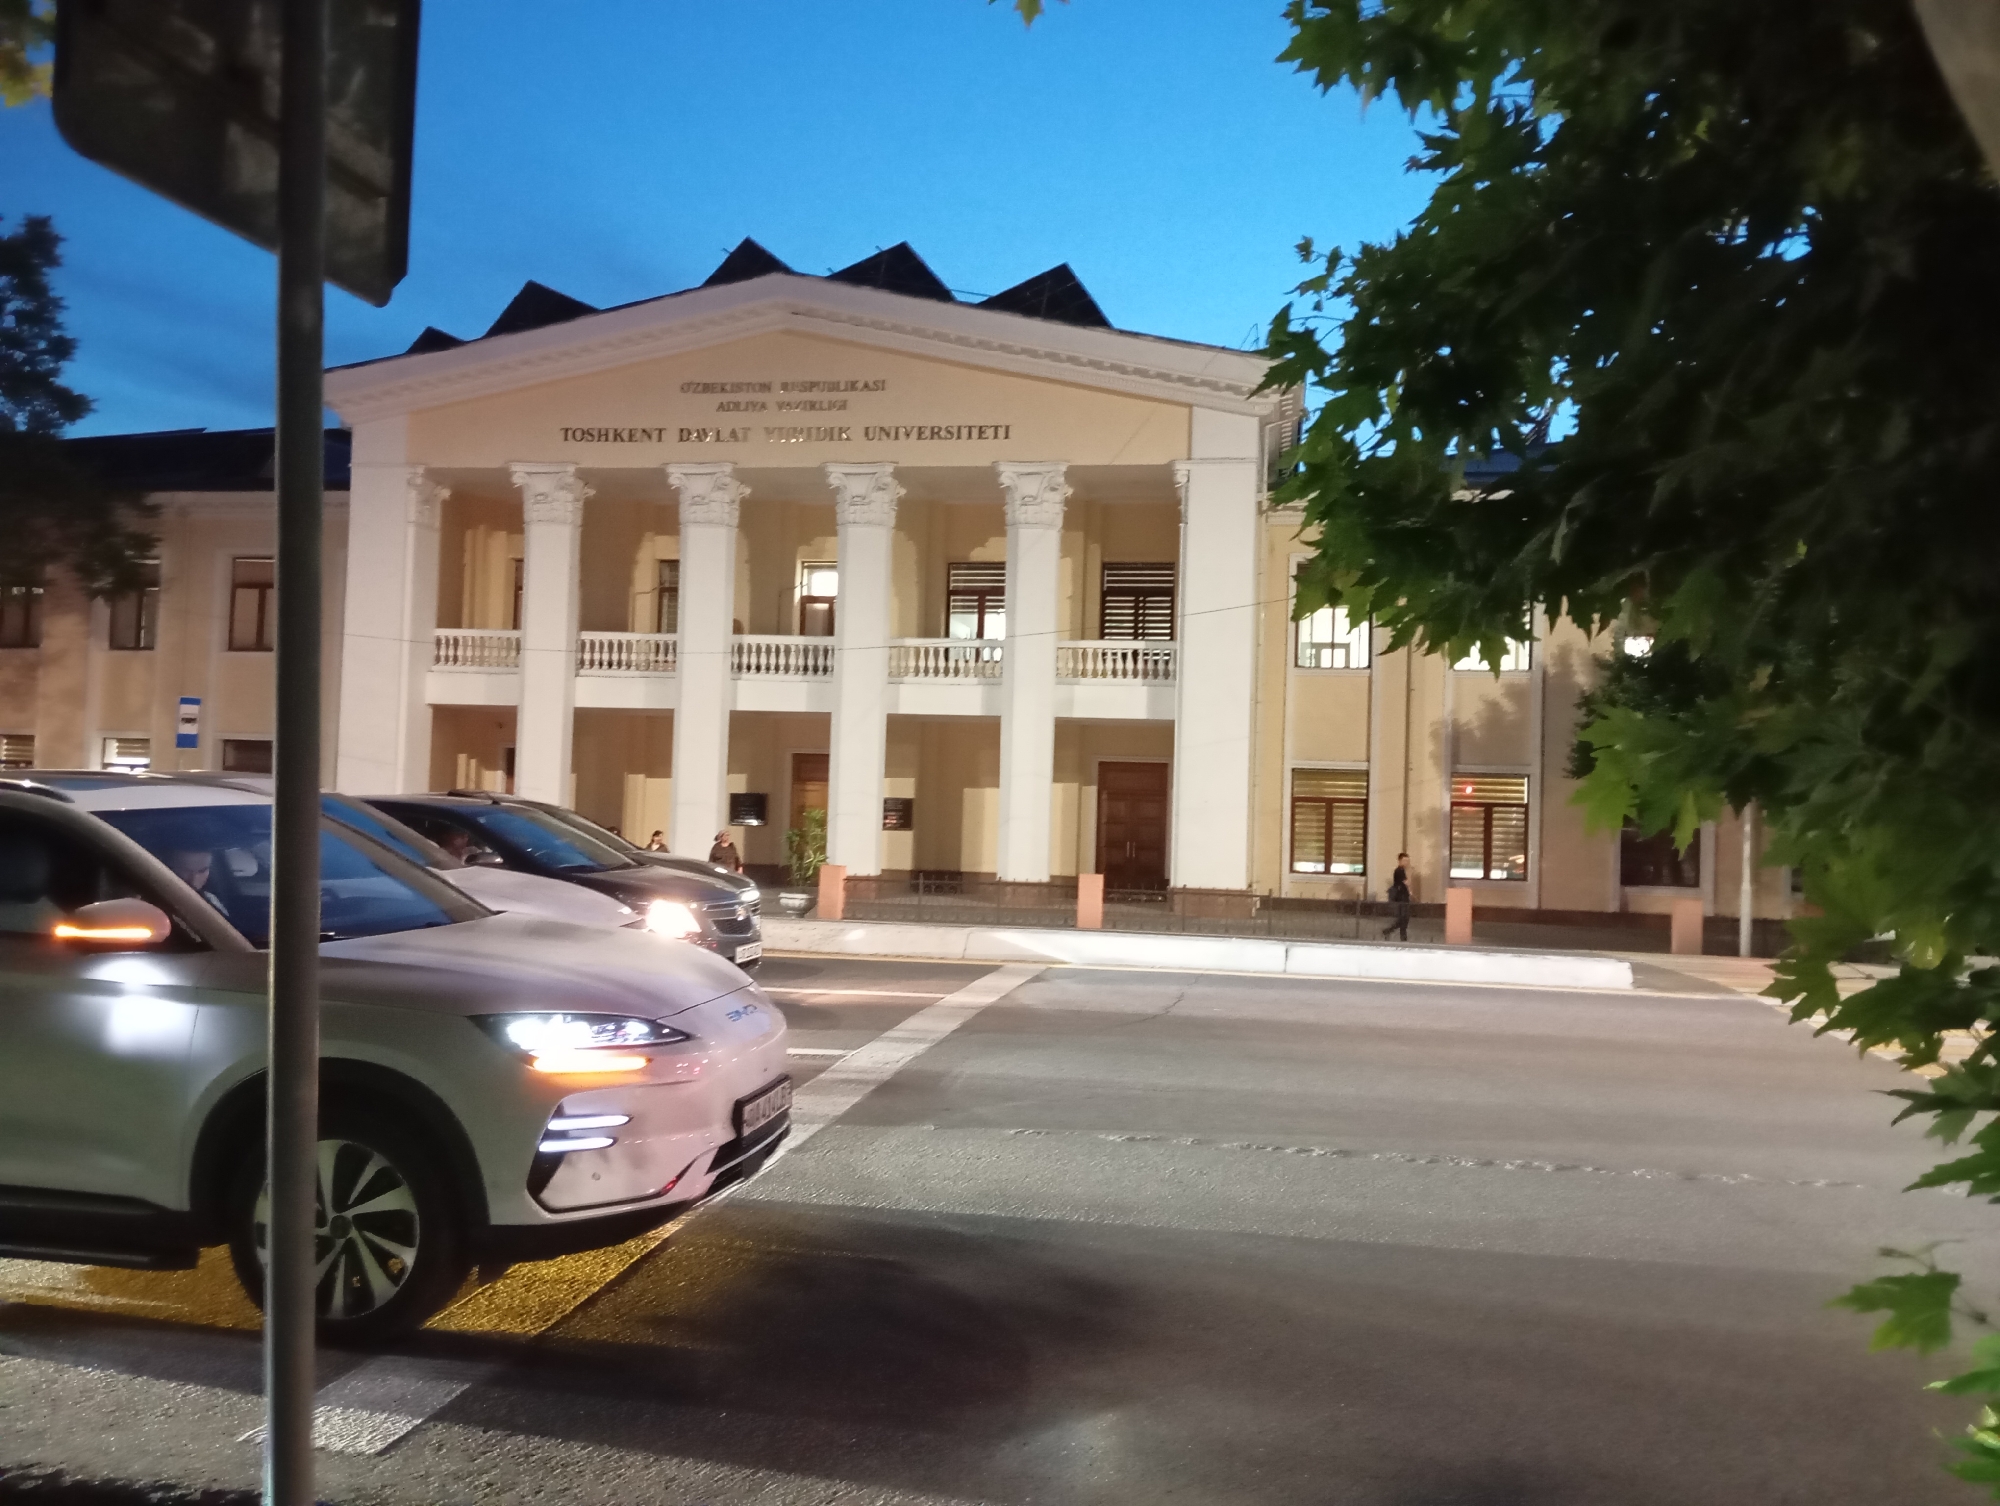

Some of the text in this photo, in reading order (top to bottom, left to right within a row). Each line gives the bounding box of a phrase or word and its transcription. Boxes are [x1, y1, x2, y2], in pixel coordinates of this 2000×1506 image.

[716, 401, 767, 412] ADLIYA
[560, 427, 667, 443] TOSHKENT
[677, 427, 751, 443] DAVLAT
[864, 424, 1012, 442] UNIVERSITETI
